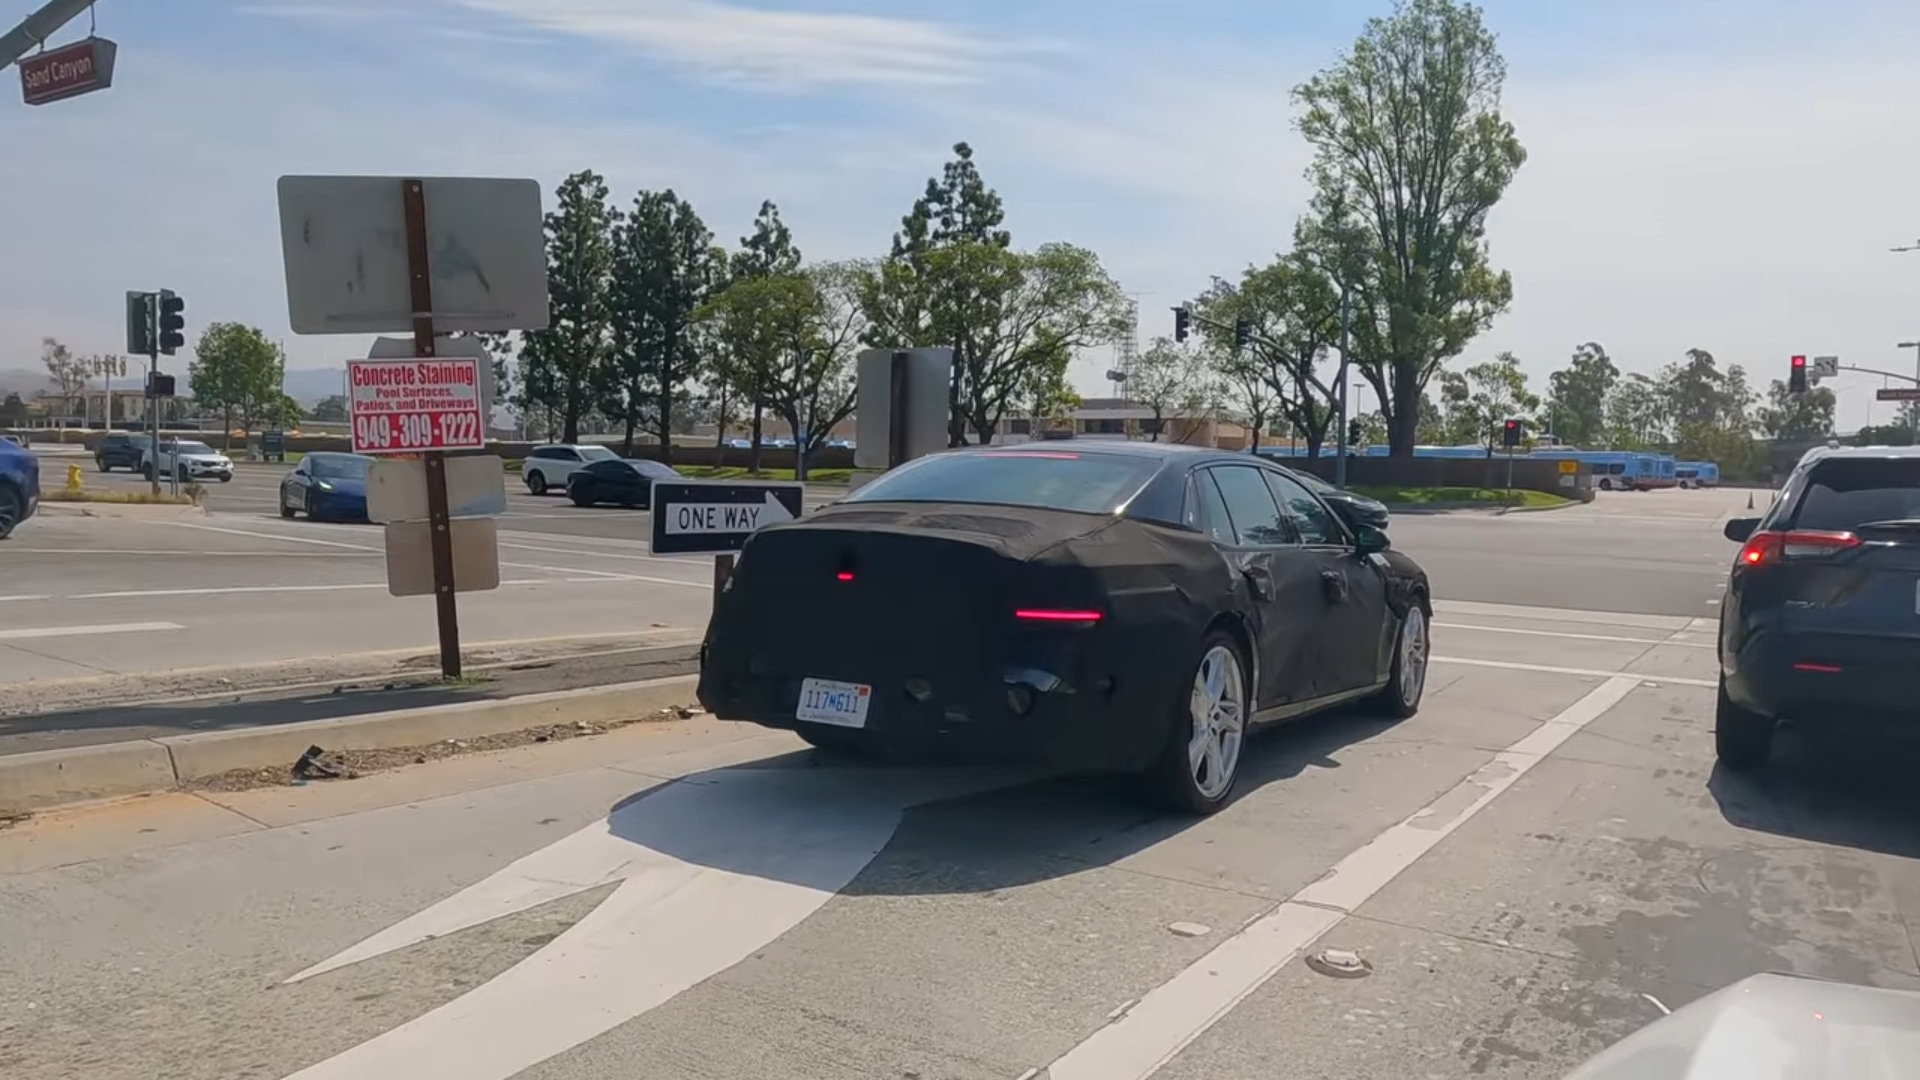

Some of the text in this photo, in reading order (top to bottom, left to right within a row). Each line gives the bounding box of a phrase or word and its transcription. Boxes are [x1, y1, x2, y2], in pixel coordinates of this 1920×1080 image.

[25, 57, 92, 89] Sand Canyon
[353, 362, 474, 387] Concrete Staining
[376, 387, 400, 399] Pool
[395, 399, 417, 410] and
[419, 398, 475, 409] Driveways
[357, 412, 478, 448] 949-309-1222
[678, 507, 761, 530] ONE WAY
